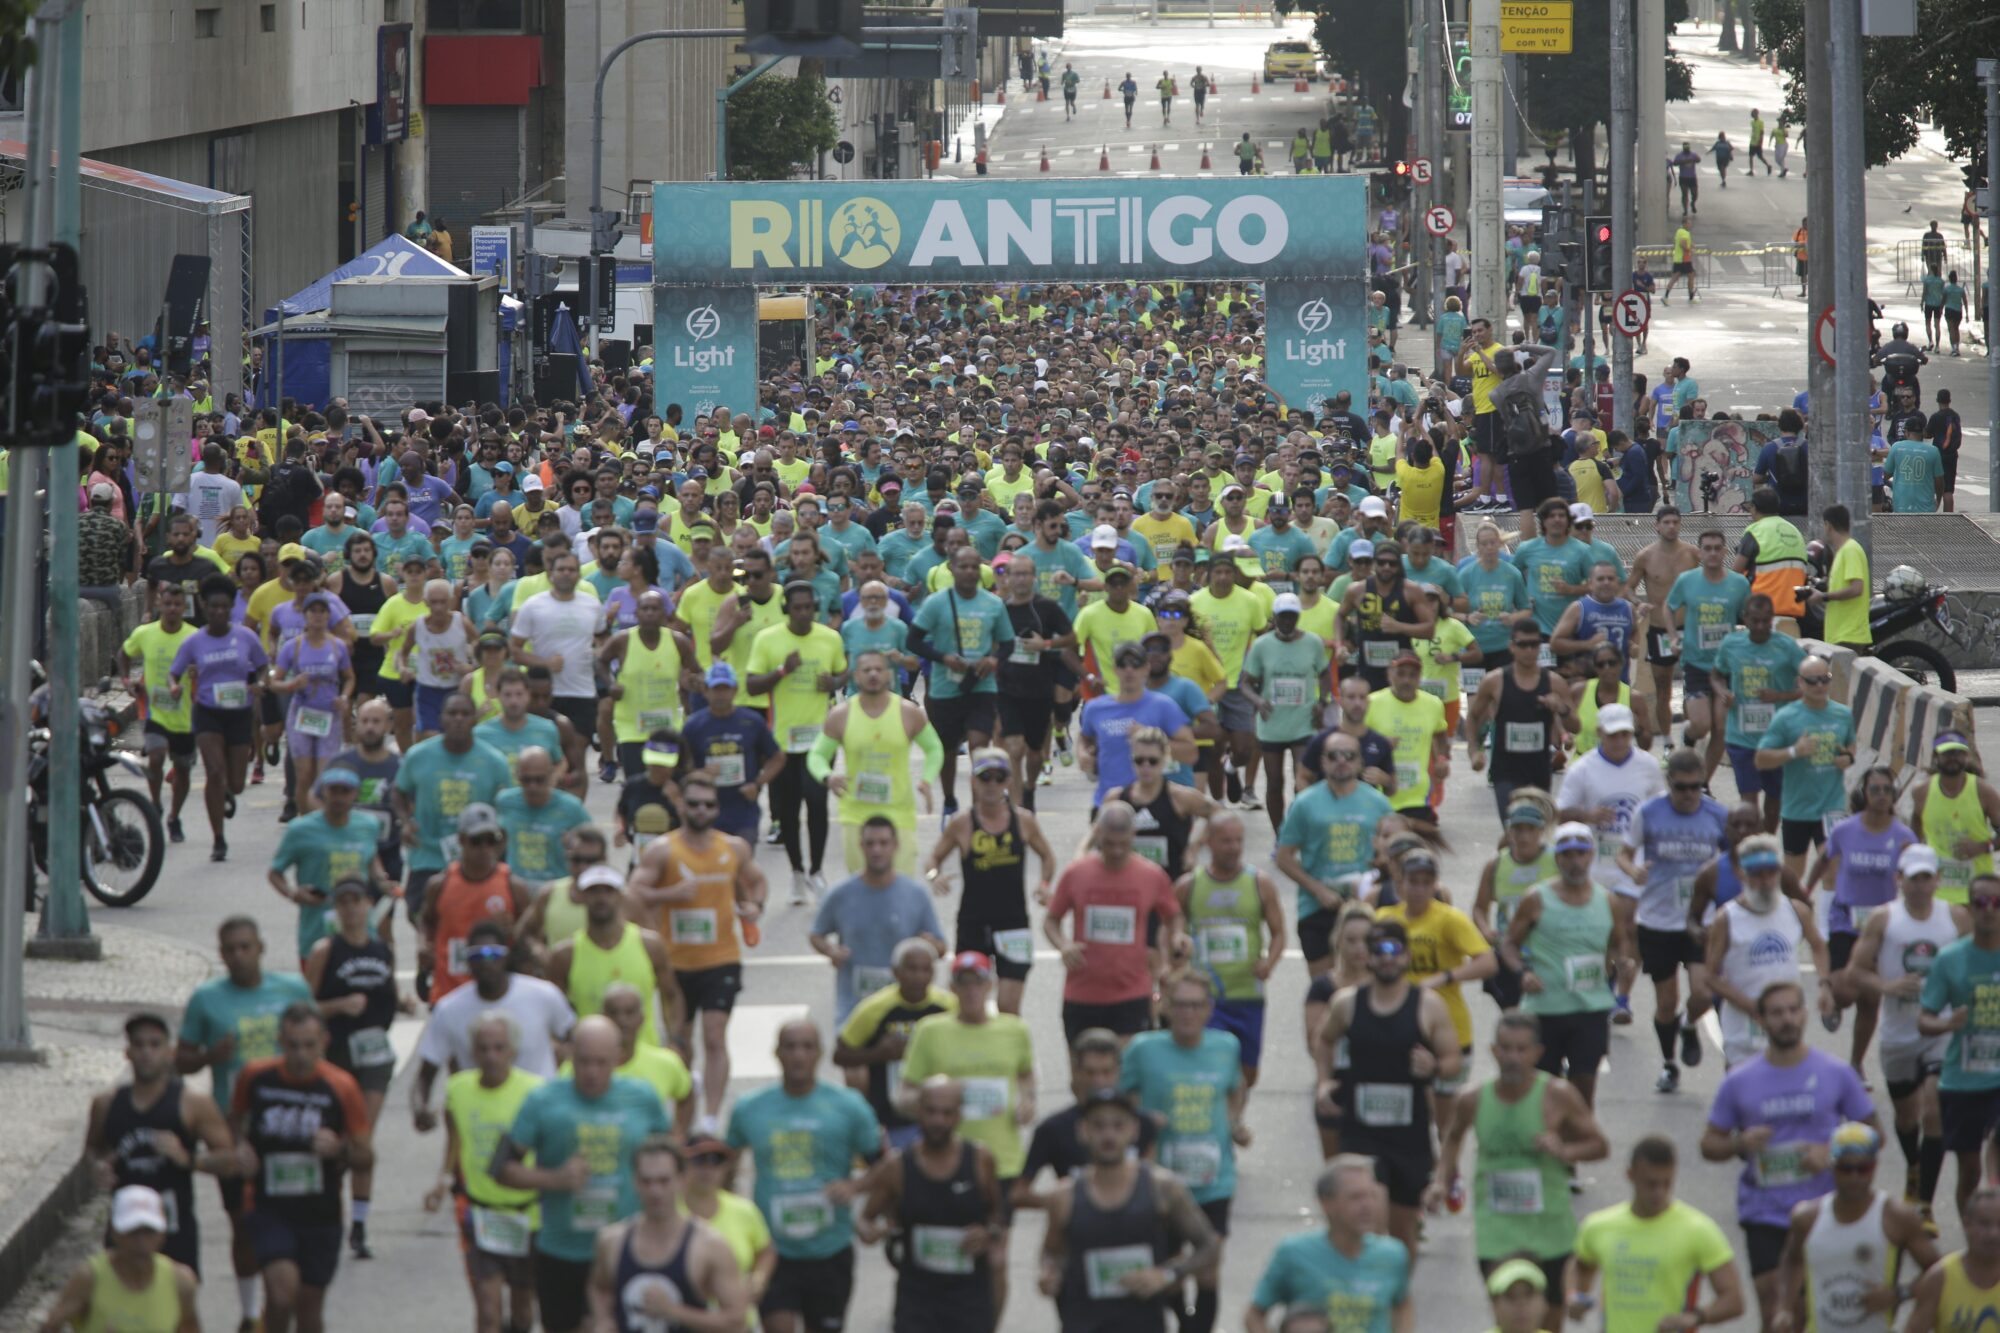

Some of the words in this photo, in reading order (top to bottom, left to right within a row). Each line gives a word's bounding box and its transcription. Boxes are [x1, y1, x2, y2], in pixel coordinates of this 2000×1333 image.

[1501, 6, 1549, 17] TENÇÃO
[1509, 26, 1565, 34] Cruzamento
[1516, 39, 1536, 47] com
[1542, 39, 1557, 47] VLT
[730, 196, 901, 270] RIO
[908, 194, 1289, 267] ANTIGO
[1434, 211, 1446, 229] E
[1625, 299, 1638, 327] E
[674, 345, 735, 373] Light
[1286, 339, 1347, 366] Light
[1901, 454, 1925, 481] 40
